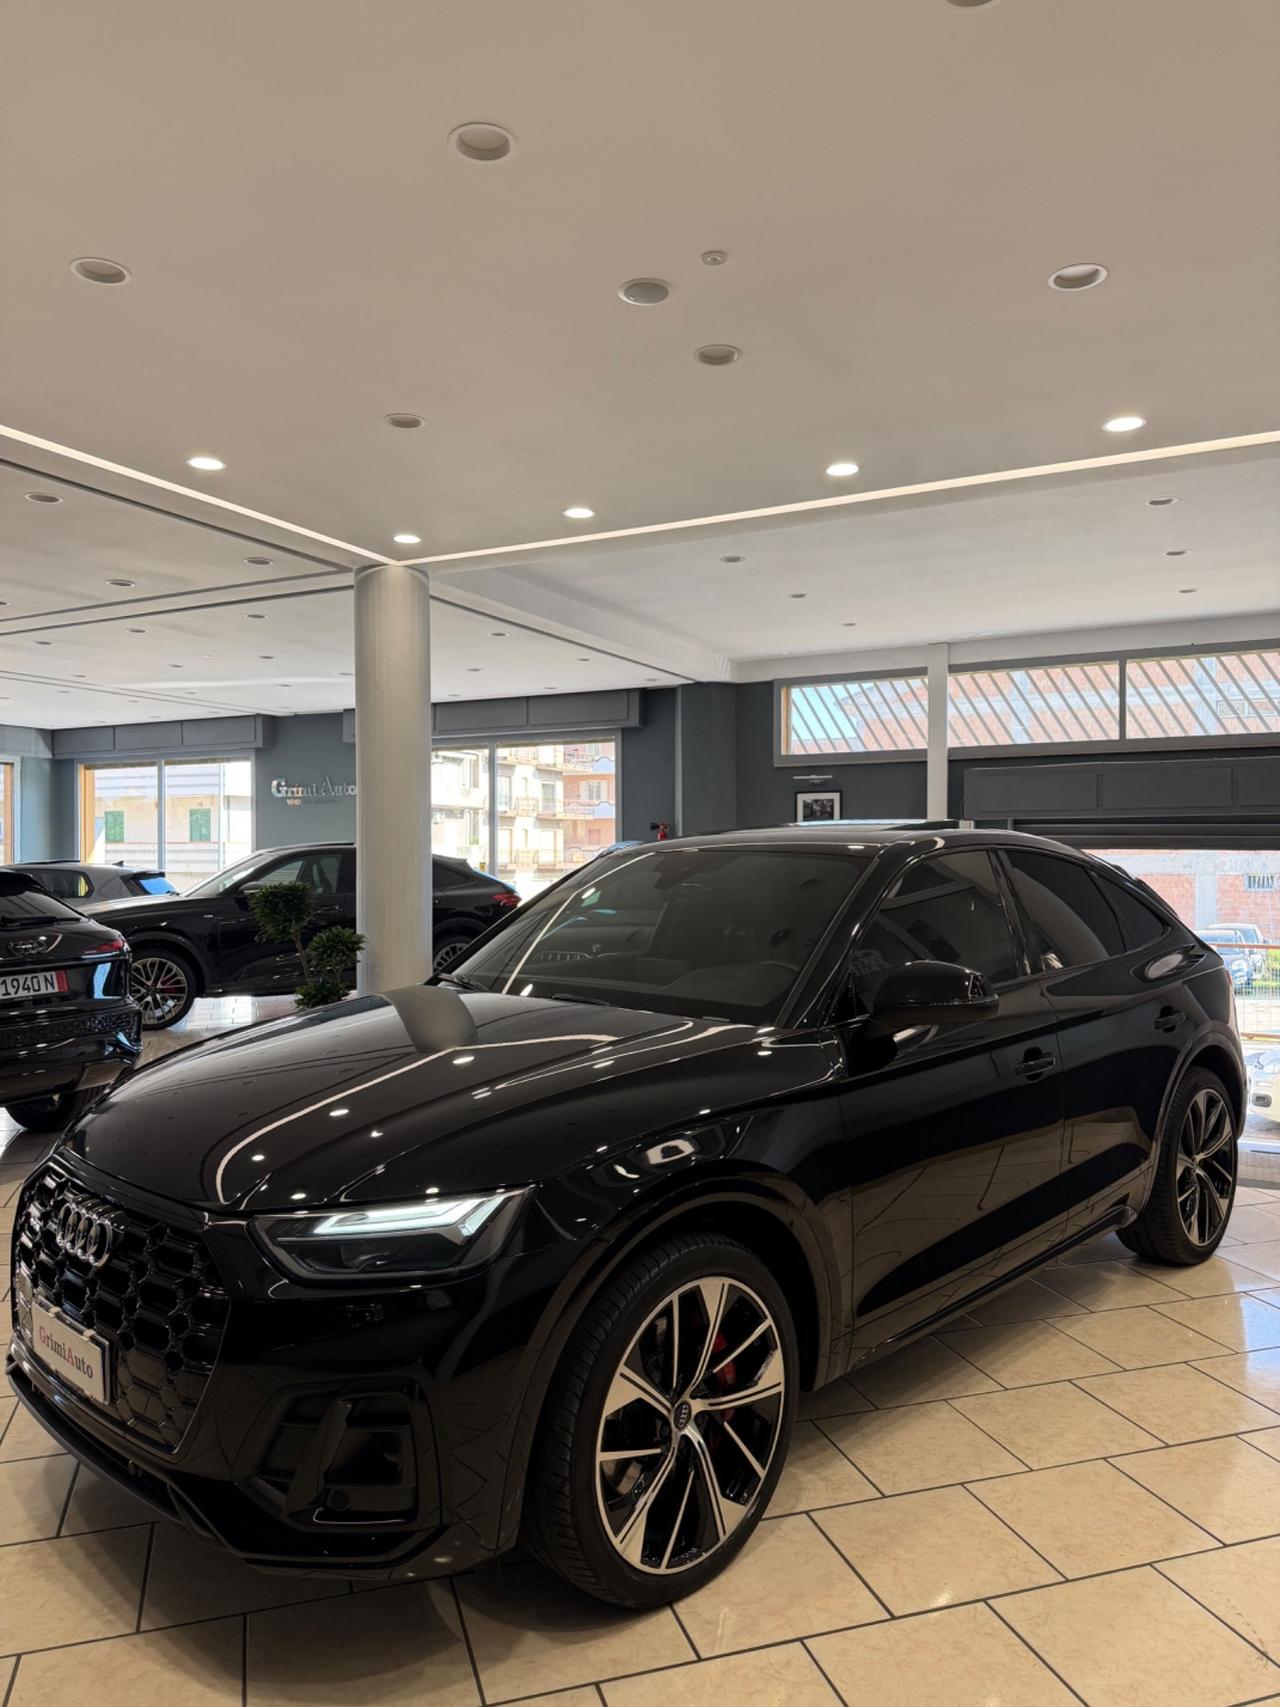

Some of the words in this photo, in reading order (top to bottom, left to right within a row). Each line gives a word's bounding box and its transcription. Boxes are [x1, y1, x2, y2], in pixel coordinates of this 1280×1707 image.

[0, 975, 40, 996] 1940
[45, 973, 56, 992] N
[39, 1326, 93, 1379] GrimiAuto
